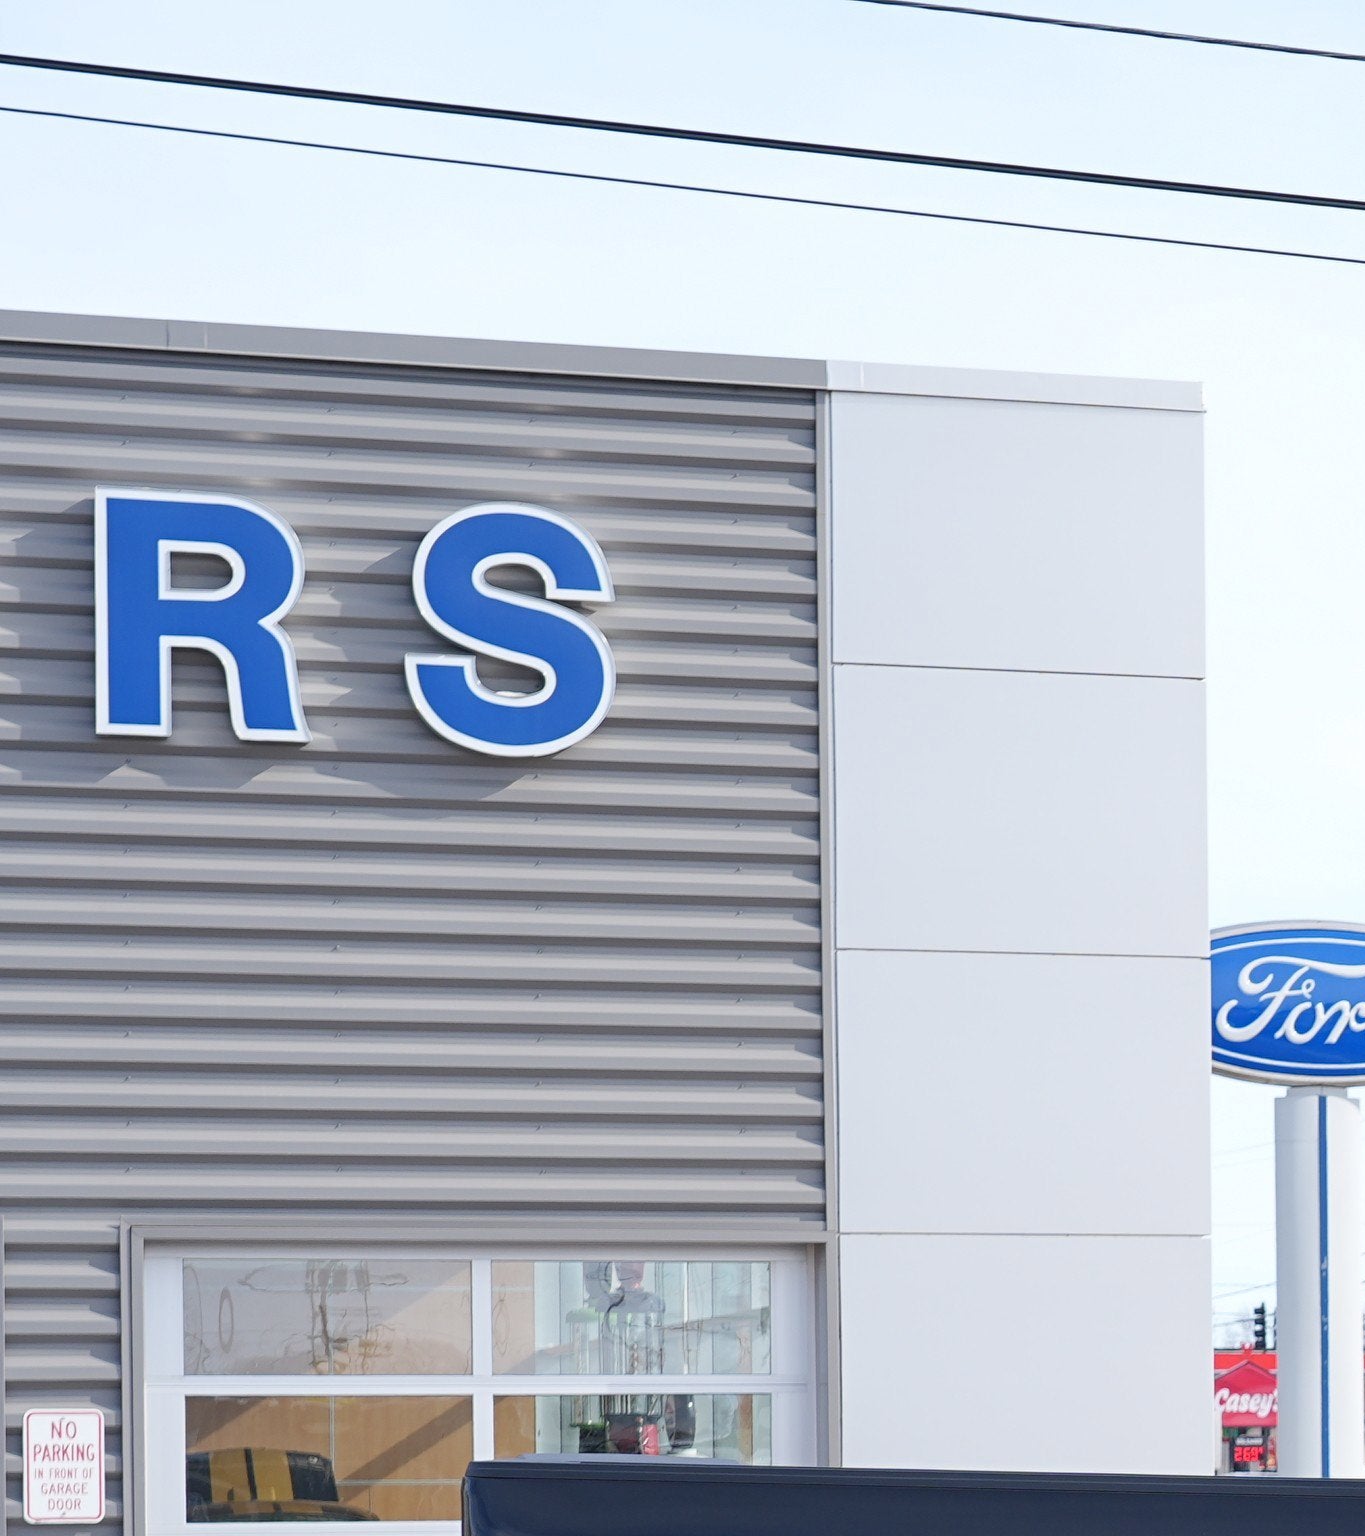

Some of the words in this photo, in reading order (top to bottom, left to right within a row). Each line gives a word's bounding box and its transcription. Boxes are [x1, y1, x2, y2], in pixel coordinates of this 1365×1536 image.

[95, 486, 311, 743] R
[404, 501, 616, 758] S
[51, 1421, 77, 1440] NO
[33, 1443, 95, 1462] PARKING
[34, 1468, 44, 1479] IN
[48, 1467, 78, 1479] FRONT
[82, 1468, 93, 1479] OF
[41, 1482, 88, 1495] GARAGE
[48, 1498, 81, 1511] DOOR
